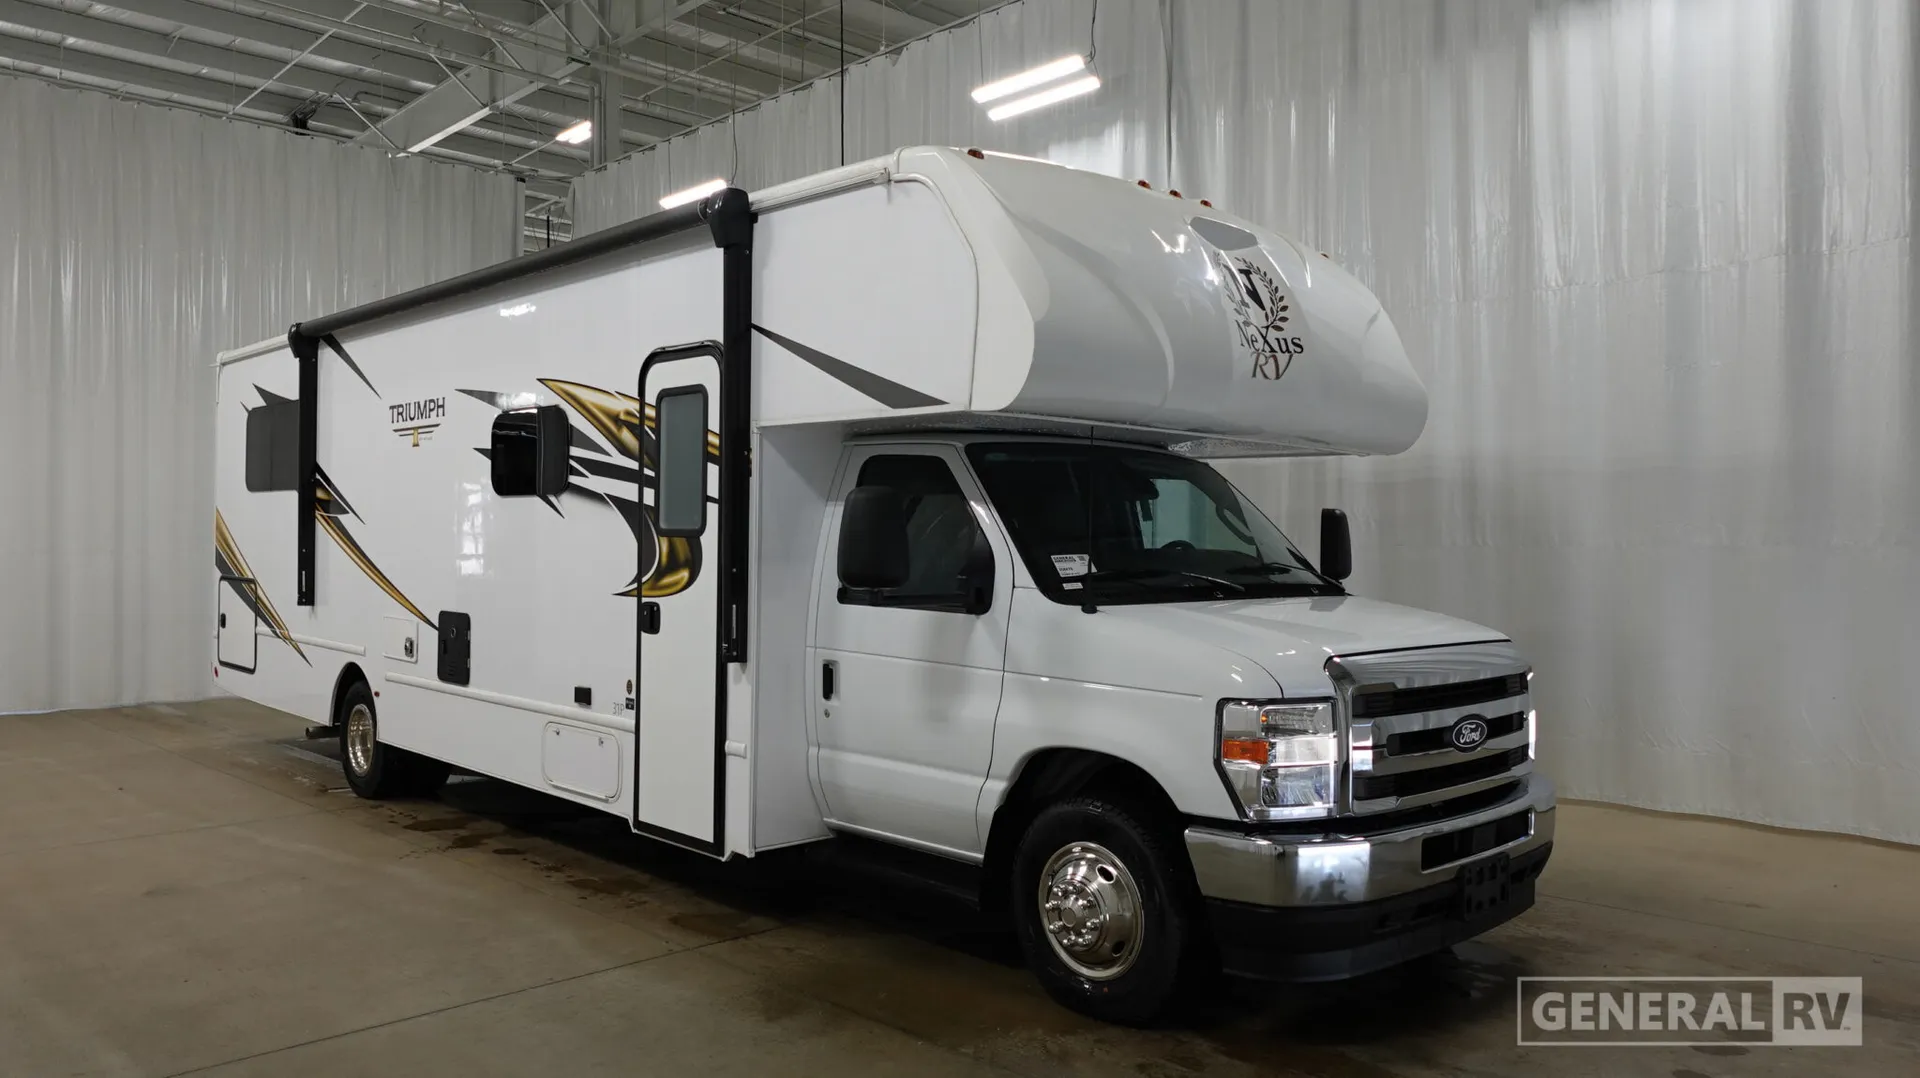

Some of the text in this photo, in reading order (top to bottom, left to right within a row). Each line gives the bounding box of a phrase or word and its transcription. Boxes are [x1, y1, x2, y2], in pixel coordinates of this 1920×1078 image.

[1234, 319, 1304, 354] NeXus
[1251, 351, 1294, 380] RV
[389, 397, 445, 424] TRIUMPH
[1460, 724, 1481, 743] Ford
